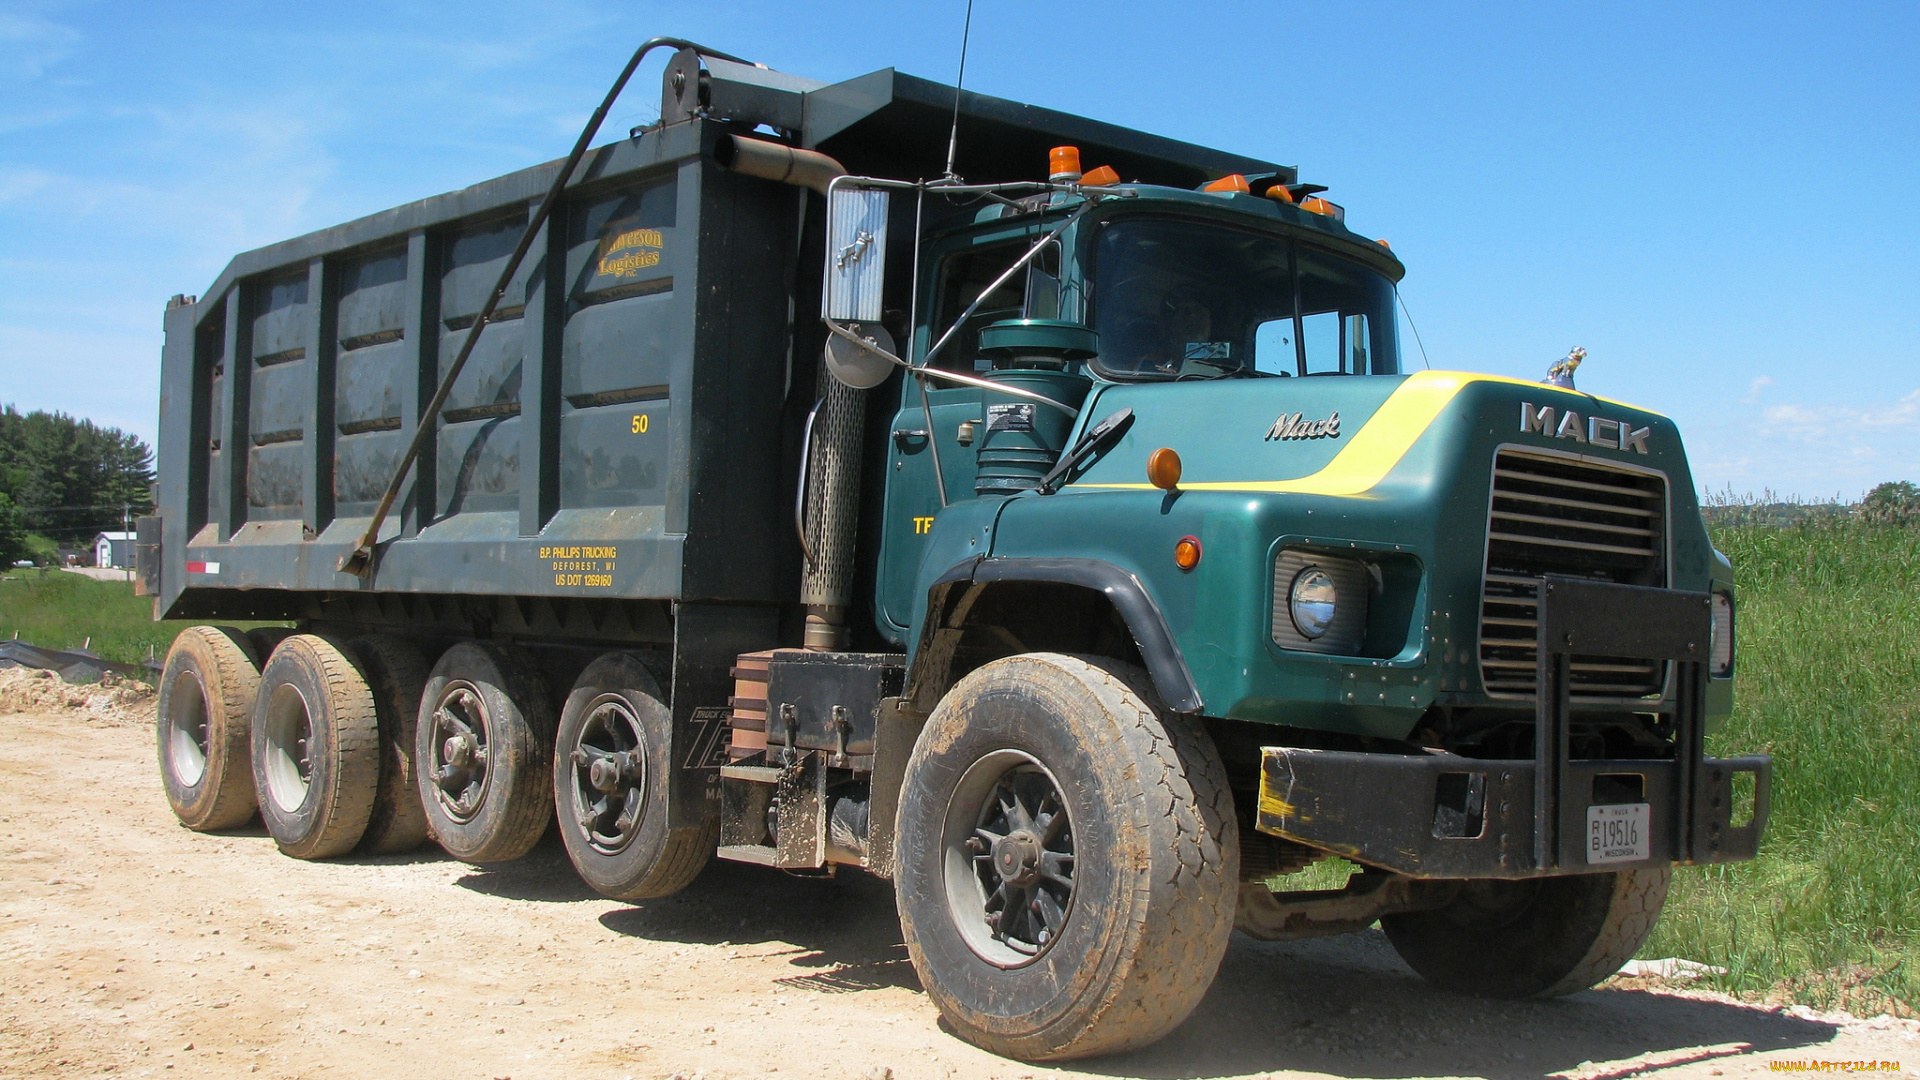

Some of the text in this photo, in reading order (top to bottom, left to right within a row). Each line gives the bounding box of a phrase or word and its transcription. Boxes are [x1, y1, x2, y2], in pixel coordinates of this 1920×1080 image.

[597, 249, 660, 278] Logistics
[631, 414, 649, 434] 50
[1264, 411, 1340, 441] Mack
[1520, 401, 1650, 455] MACK
[553, 547, 580, 558] PHILLIPS
[582, 546, 617, 558] TRUCKING
[552, 562, 616, 572] DEFOREST, WI
[555, 574, 566, 586] US
[567, 574, 582, 586] DOT
[1603, 819, 1637, 848] 19516
